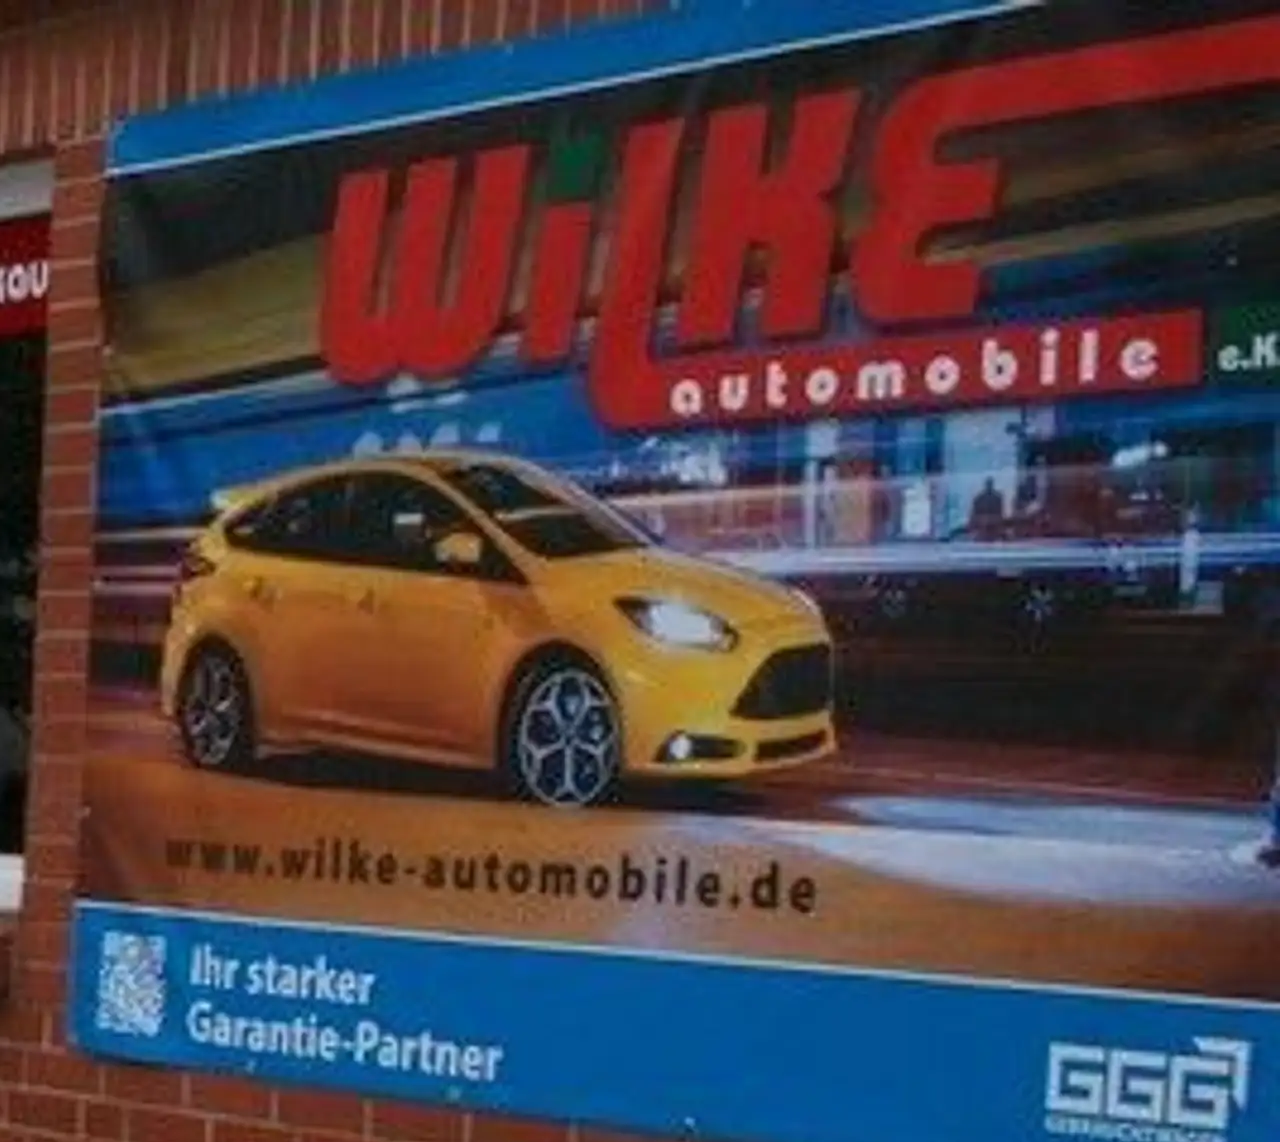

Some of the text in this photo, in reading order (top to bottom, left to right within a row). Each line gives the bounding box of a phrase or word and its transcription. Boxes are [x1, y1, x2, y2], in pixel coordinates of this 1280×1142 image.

[670, 328, 1161, 415] automobile
[165, 834, 817, 914] www.wilke-automobile.de
[191, 944, 376, 1005] Ihr starker
[187, 1001, 505, 1082] Garantie-Partner
